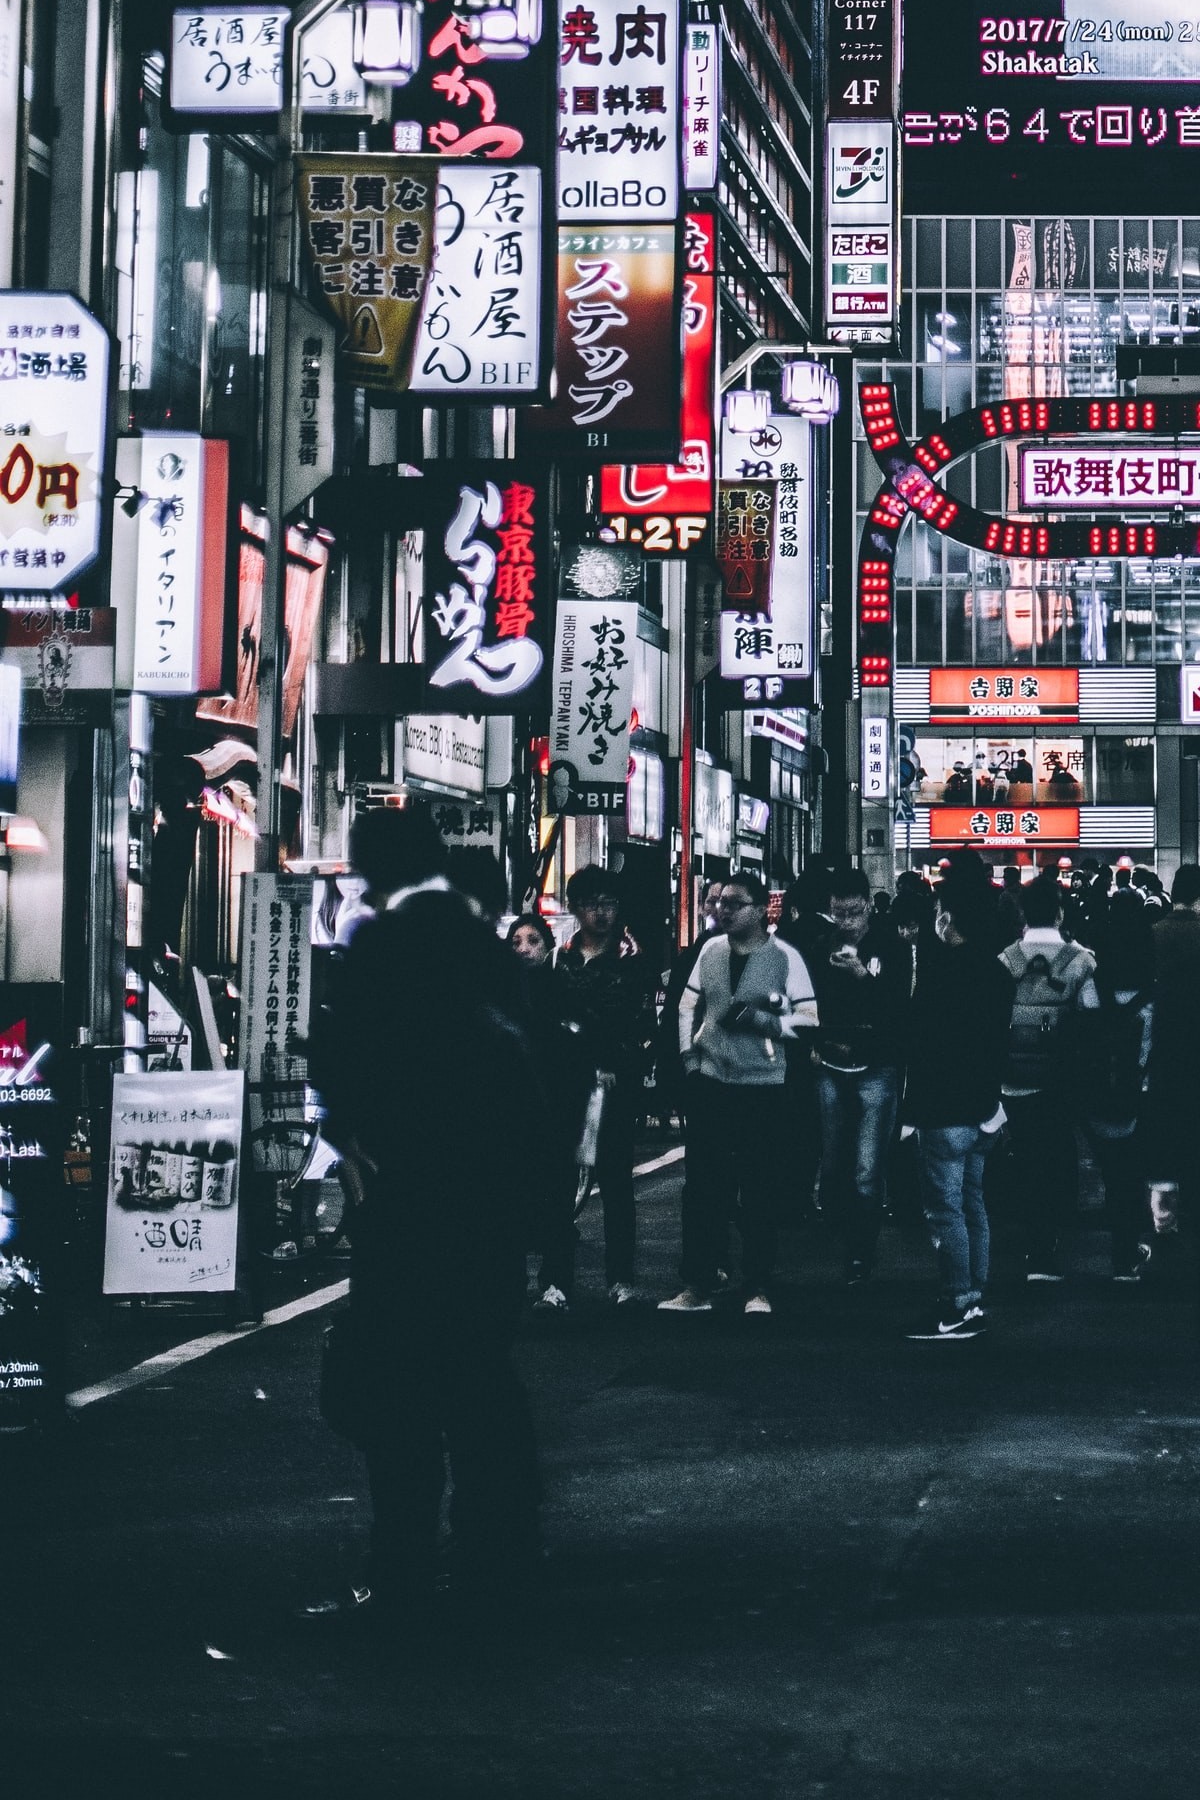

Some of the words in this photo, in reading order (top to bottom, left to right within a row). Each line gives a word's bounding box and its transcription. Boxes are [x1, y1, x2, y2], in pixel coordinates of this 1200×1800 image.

[844, 14, 878, 31] 117
[981, 51, 1099, 75] Shakatak
[842, 79, 881, 106] 4F
[692, 55, 711, 158] リーチ麻雀
[309, 175, 428, 214] 悪質な
[557, 179, 667, 210] ollaBo
[309, 219, 424, 257] 客引き
[833, 234, 889, 255] たばこ
[469, 171, 528, 340] 居酒屋
[320, 263, 424, 299] に注意
[846, 263, 872, 285] 酒
[834, 296, 887, 312] 銀行ATM
[564, 257, 634, 426] ステップ
[479, 361, 532, 386] B1F
[586, 431, 609, 448] B1
[496, 480, 537, 640] 東京豚骨
[560, 614, 577, 674] HIROSHIMA
[137, 670, 190, 680] KABUKICHO
[743, 676, 785, 700] 2F
[968, 675, 1040, 702] 吉野家
[576, 615, 630, 766] お好み焼き
[554, 679, 573, 752] TEPPANYAKI
[968, 704, 1041, 716] YOSHINOYA
[869, 724, 883, 792] 劇場通り
[586, 791, 625, 808] B1F
[435, 805, 494, 837] 焼肉
[970, 811, 1041, 836] 吉野家
[983, 837, 1026, 845] YOSHINOYA
